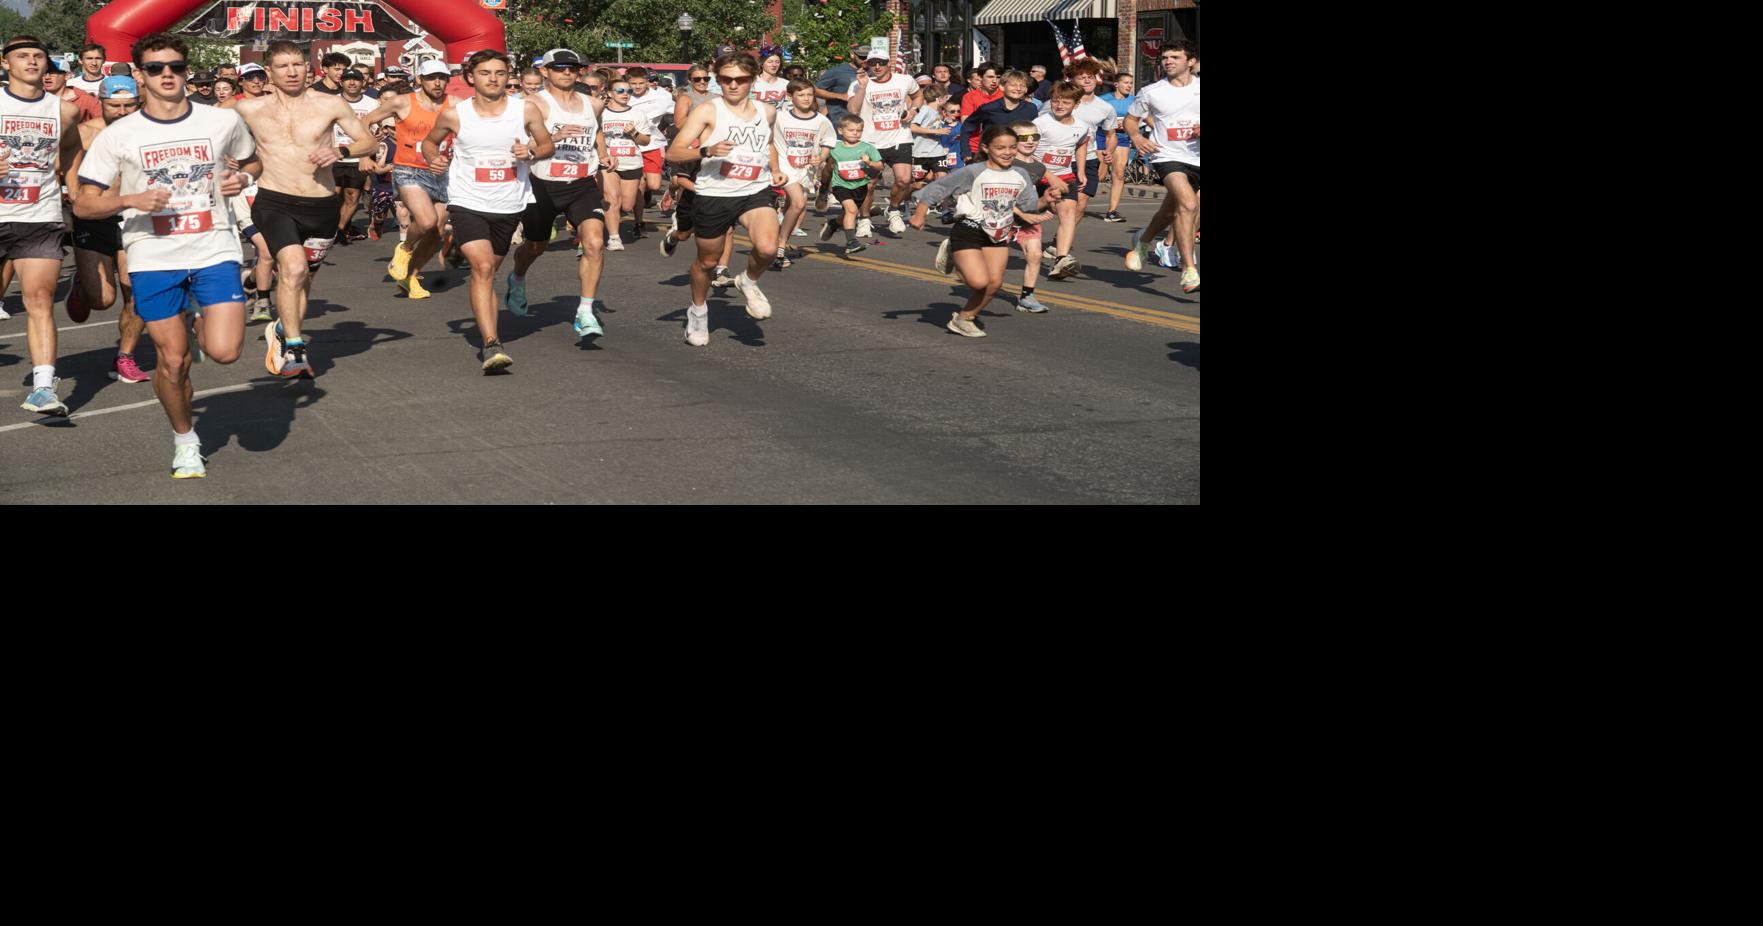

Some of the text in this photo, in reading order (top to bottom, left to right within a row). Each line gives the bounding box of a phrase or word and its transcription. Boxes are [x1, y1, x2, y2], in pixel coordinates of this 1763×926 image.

[227, 6, 375, 33] FINISH
[751, 90, 788, 101] USA
[4, 120, 54, 136] FREEDOM 5K
[880, 121, 895, 129] 432
[563, 136, 592, 145] TATE
[785, 130, 809, 140] FREEDOM
[144, 144, 210, 168] FREEDOM 5K
[794, 156, 808, 165] 481
[1050, 155, 1067, 165] 393
[489, 169, 505, 181] 59
[563, 164, 578, 175] 28
[729, 164, 753, 178] 279
[847, 170, 859, 178] 29
[4, 188, 29, 201] 241
[984, 187, 1013, 199] FREEDOM
[168, 214, 201, 231] 175
